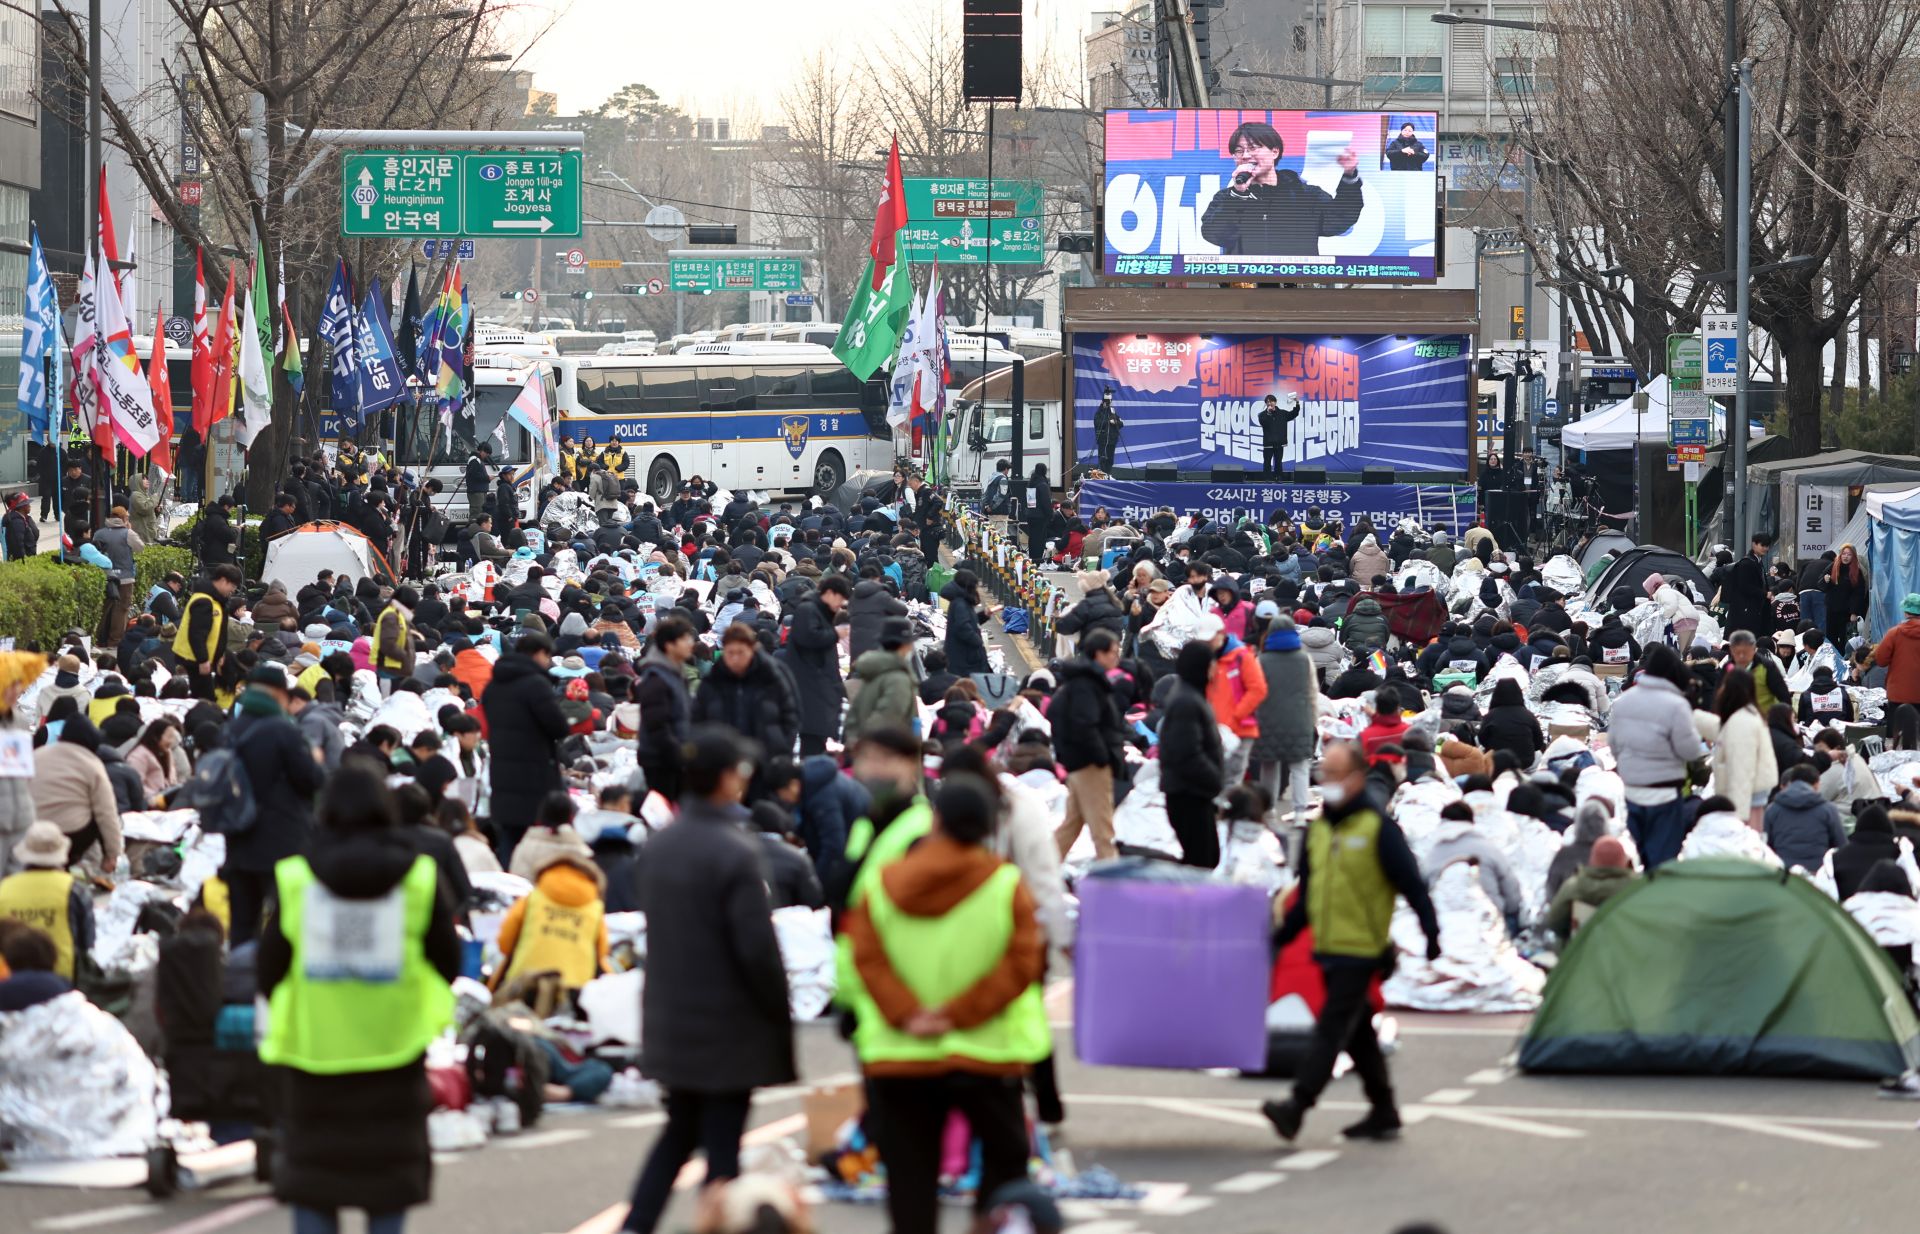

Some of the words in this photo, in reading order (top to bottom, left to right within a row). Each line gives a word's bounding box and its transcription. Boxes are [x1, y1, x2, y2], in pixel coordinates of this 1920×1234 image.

[383, 158, 453, 177] 흥인지문
[487, 168, 495, 178] 6
[384, 178, 441, 191] 興仁之門
[505, 177, 535, 188] Jongno
[930, 183, 965, 194] 흥인지문
[358, 189, 373, 202] 50
[384, 195, 444, 207] Heunginjimun
[505, 188, 551, 202] 조계사
[505, 203, 552, 213] Jogyesa
[937, 202, 965, 212] 창덕궁
[384, 211, 440, 230] 안국역
[901, 230, 939, 240] 법재판소
[571, 253, 581, 262] 50
[1115, 261, 1172, 274] 비상행동
[1184, 264, 1239, 274] 카카오뱅크
[1242, 264, 1343, 275] 7942-09-53862
[1346, 265, 1379, 276] 심규협
[1118, 342, 1160, 356] 24시간
[1164, 342, 1191, 356] 철야
[1126, 359, 1152, 374] 집중
[1156, 359, 1181, 374] 행동
[1200, 336, 1274, 397] 헌재를
[110, 384, 151, 429] 노동조합
[614, 424, 647, 437] POLICE
[820, 419, 839, 431] 경찰
[1261, 488, 1288, 503] 철야
[1122, 505, 1175, 525] 헌재
[1806, 494, 1823, 533] 타로
